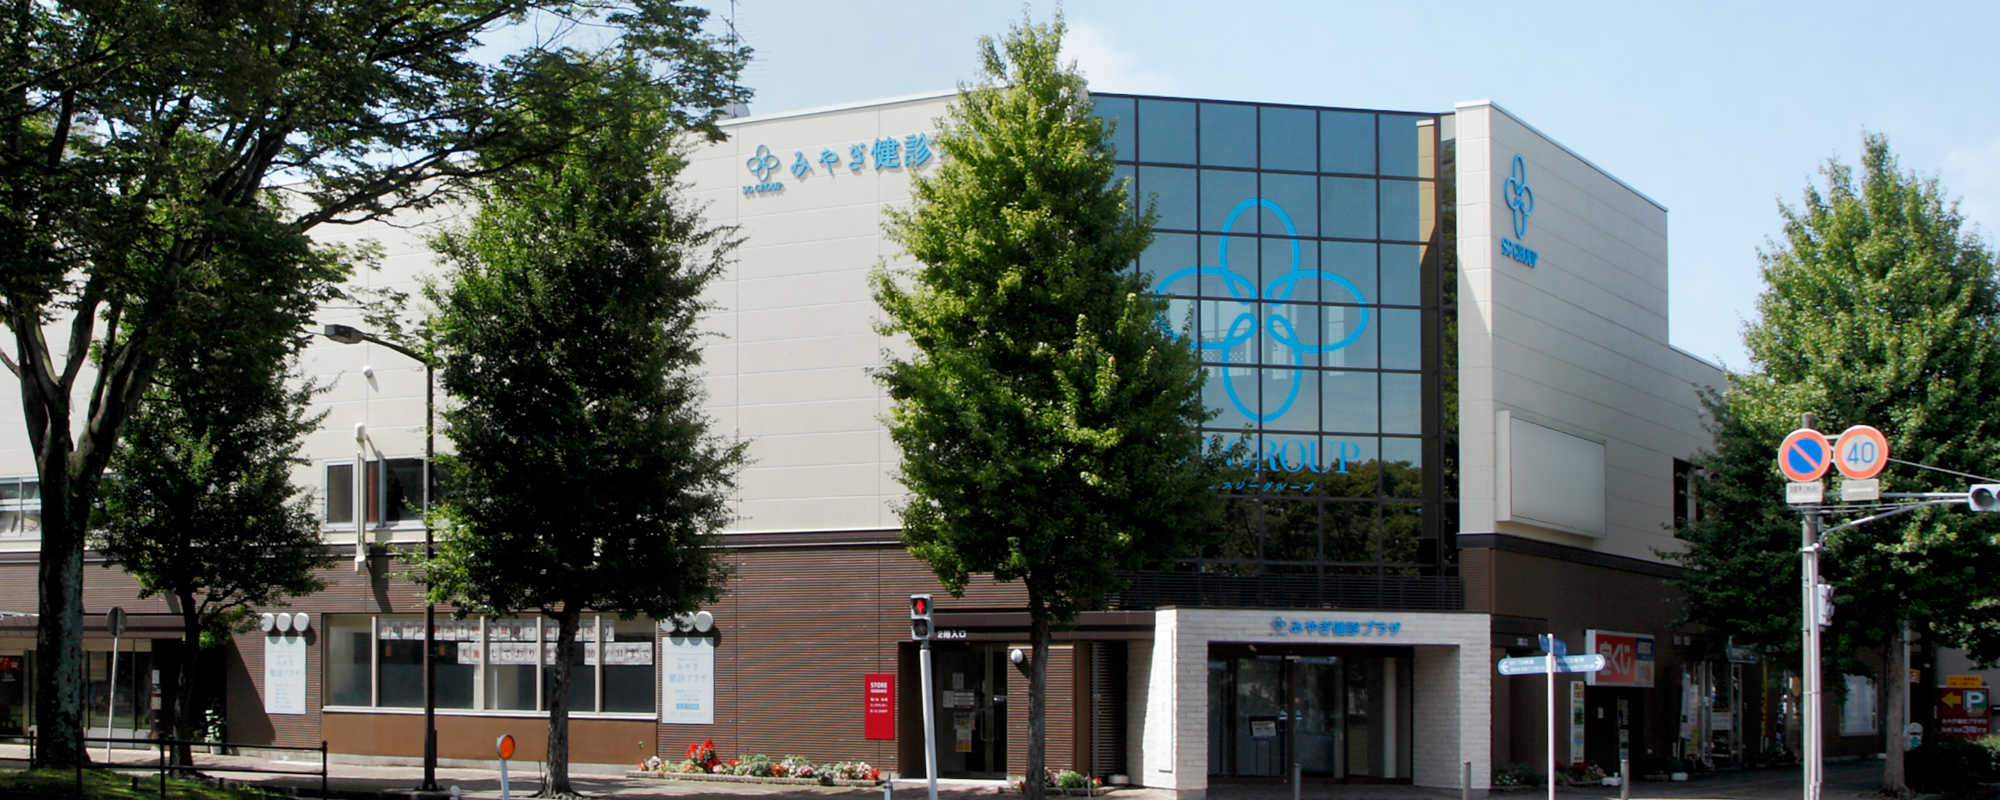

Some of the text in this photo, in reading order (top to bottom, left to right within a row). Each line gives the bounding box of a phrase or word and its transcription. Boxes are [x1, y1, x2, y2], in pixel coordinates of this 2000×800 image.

[790, 132, 947, 178] みやぎ健診
[1226, 437, 1360, 474] GROUP
[1847, 441, 1874, 464] 40
[1208, 481, 1315, 493] スジーグループ
[1289, 620, 1402, 636] みやぎ健診プラザ
[1599, 641, 1631, 676] 宝くじ
[1966, 692, 1984, 709] P
